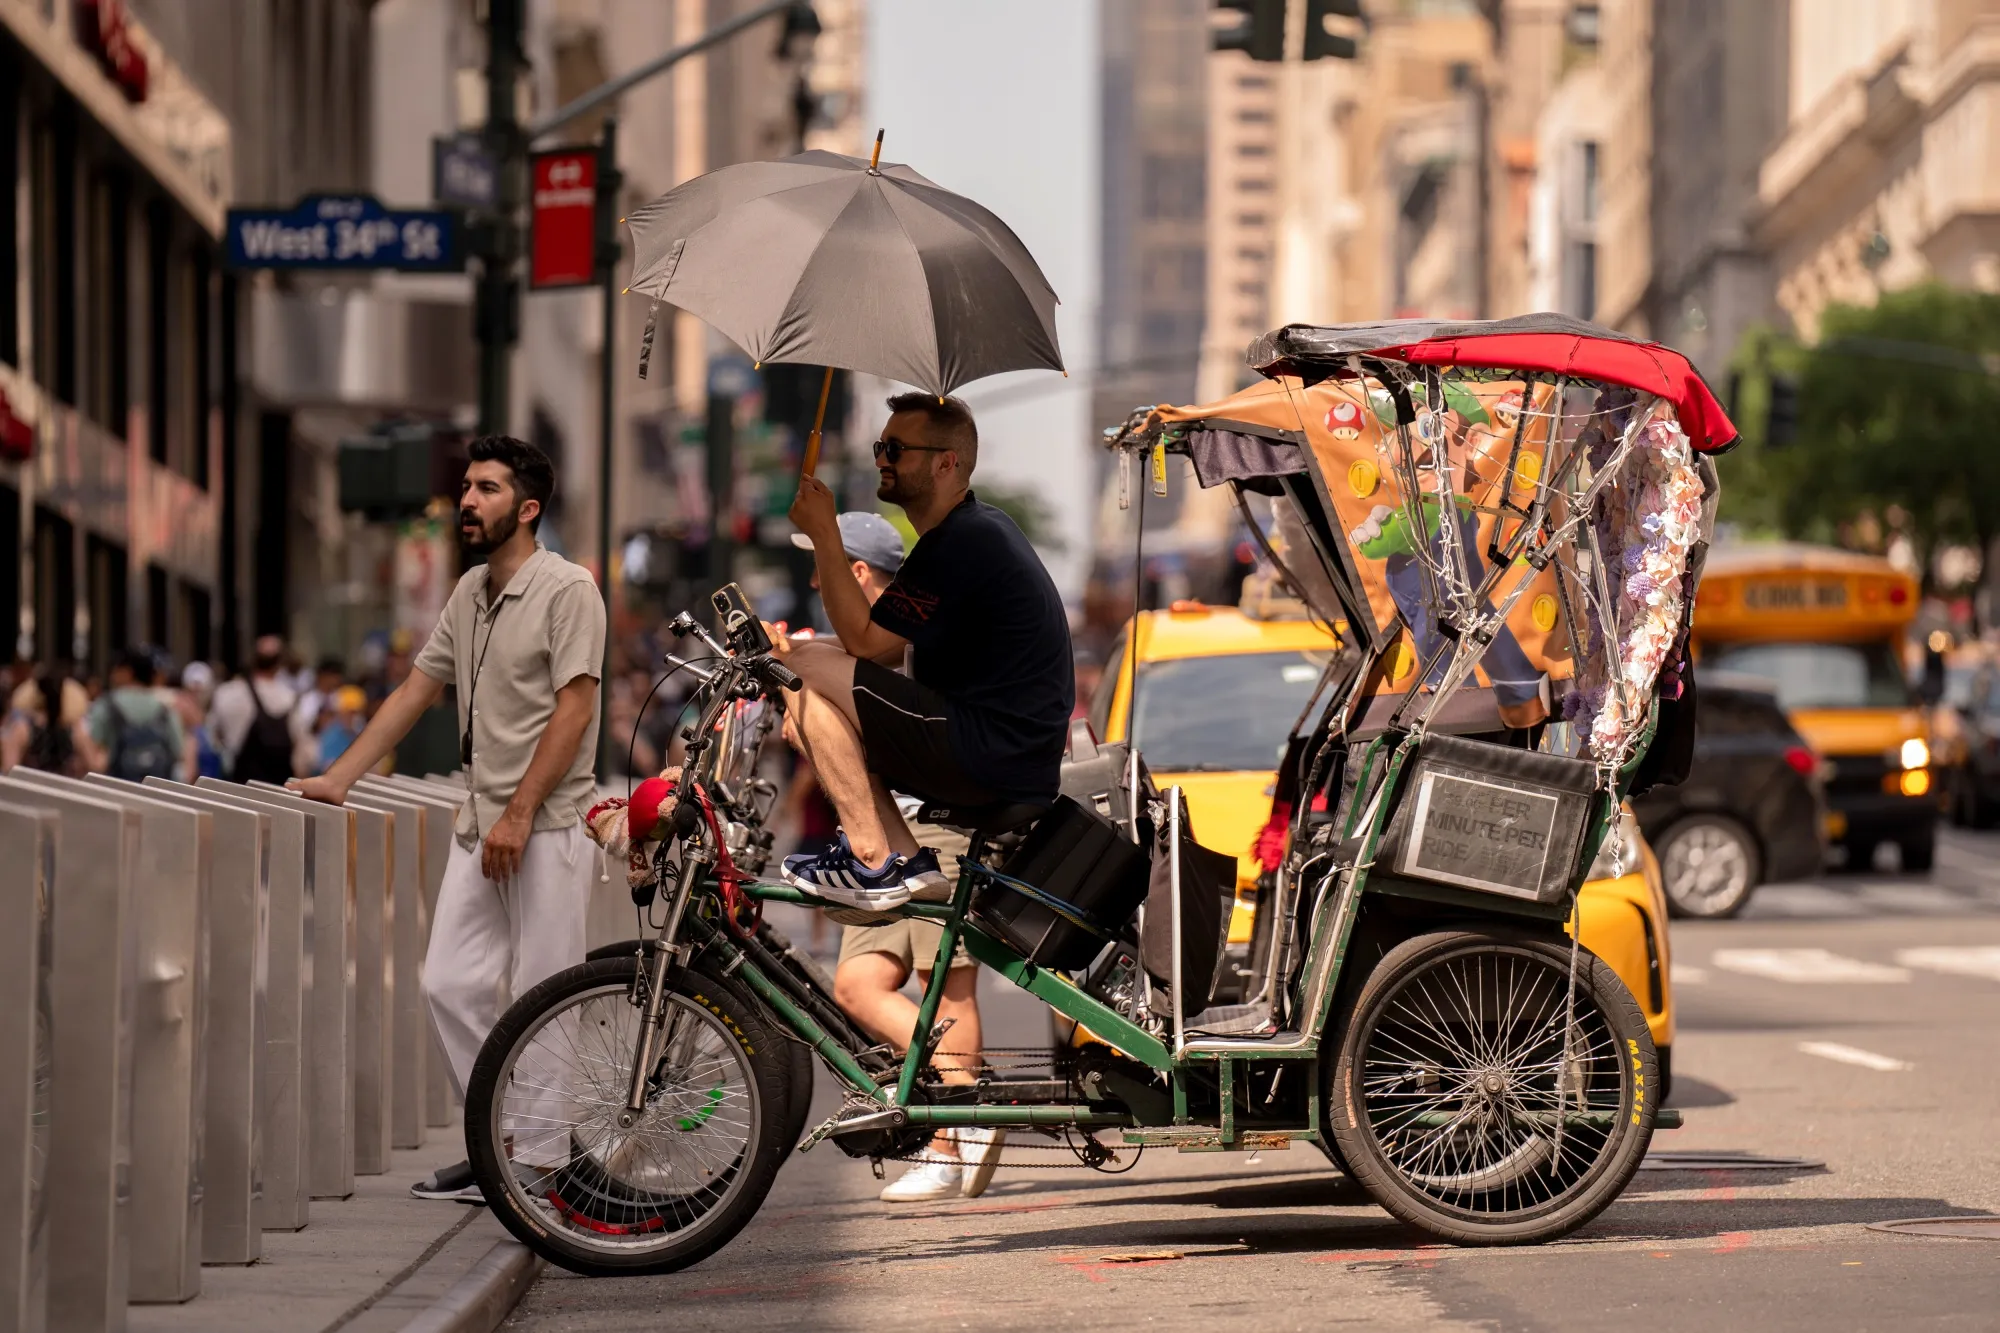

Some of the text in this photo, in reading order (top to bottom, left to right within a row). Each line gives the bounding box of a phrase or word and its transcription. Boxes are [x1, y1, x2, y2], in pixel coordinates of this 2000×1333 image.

[240, 220, 328, 259] West
[402, 221, 440, 259] St
[929, 809, 950, 818] C9
[1490, 796, 1531, 820] PER
[1422, 837, 1471, 861] RIDE
[1426, 810, 1547, 850] MINUTE PER
[694, 994, 754, 1055] MAXXIS
[1627, 1039, 1644, 1126] MAXXIS
